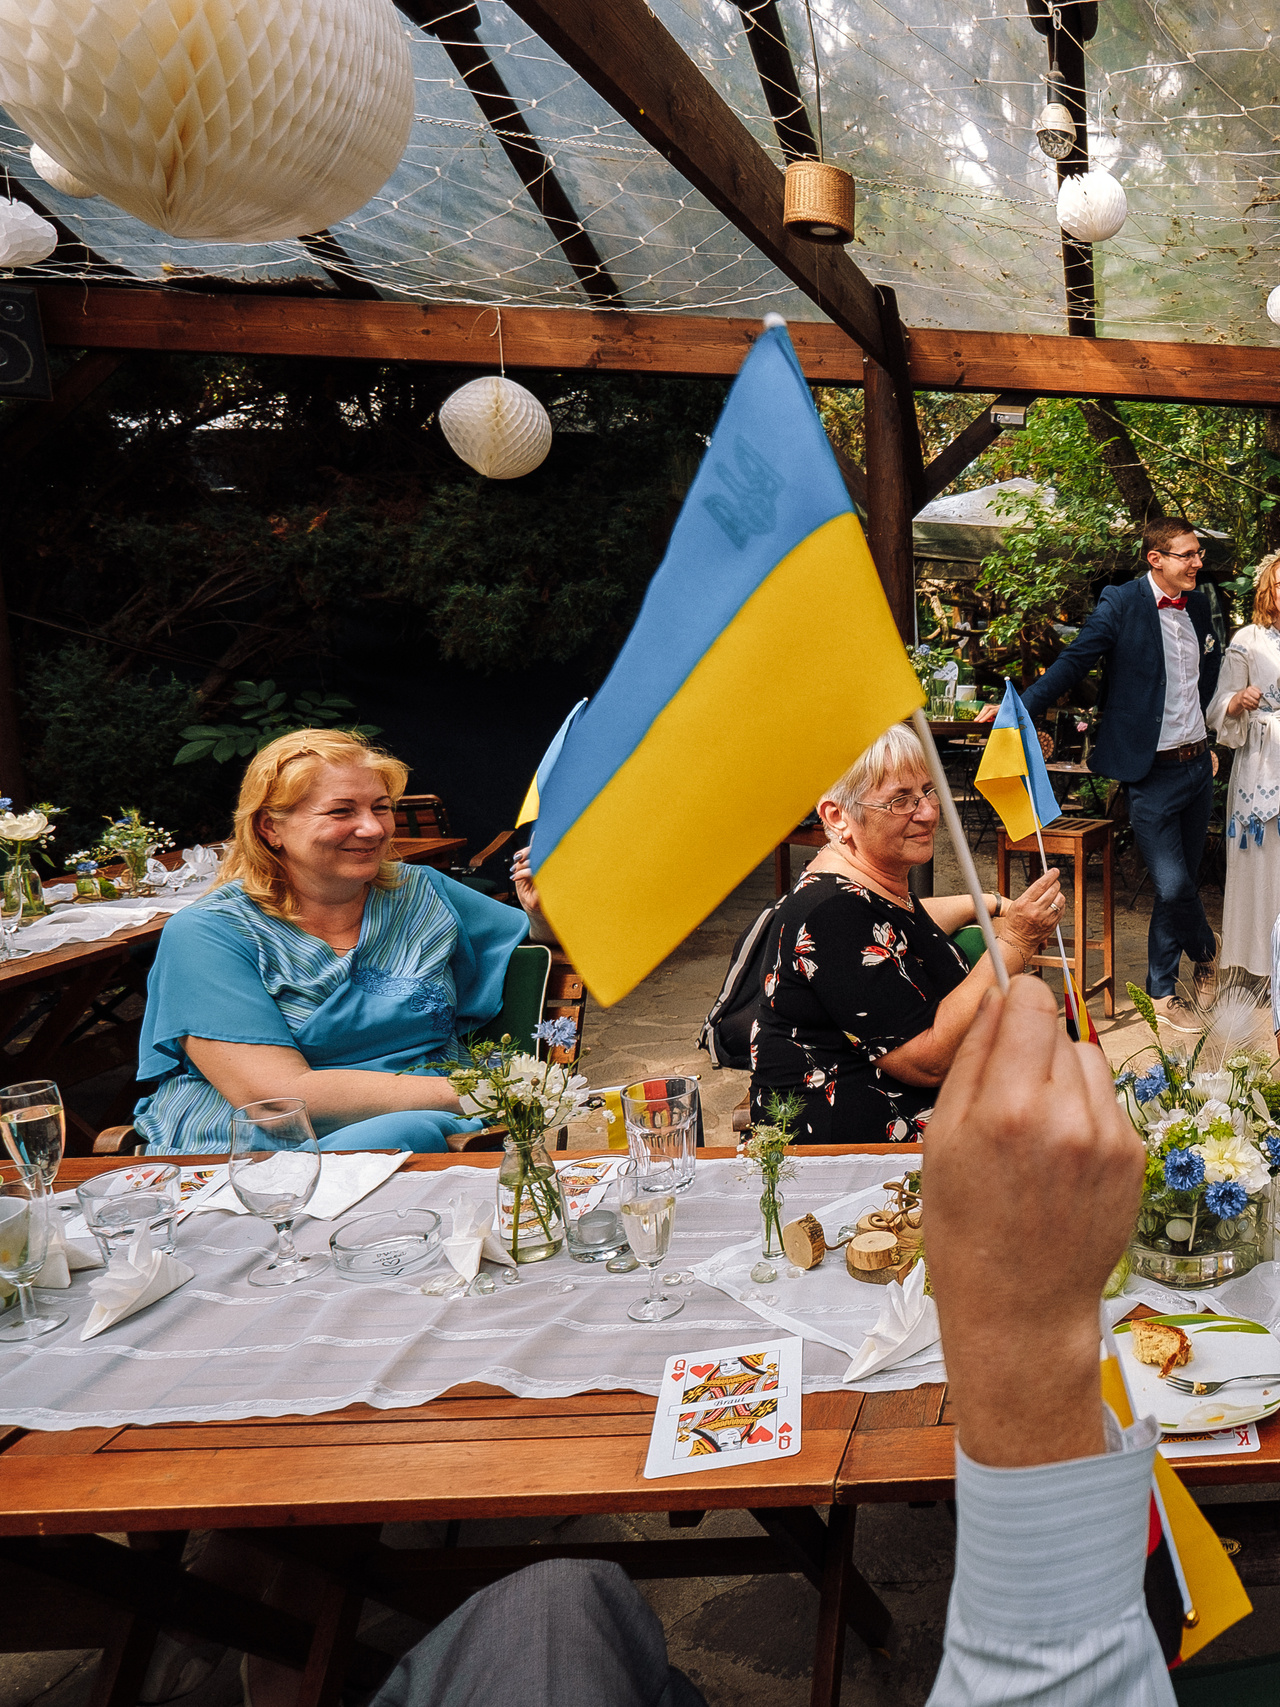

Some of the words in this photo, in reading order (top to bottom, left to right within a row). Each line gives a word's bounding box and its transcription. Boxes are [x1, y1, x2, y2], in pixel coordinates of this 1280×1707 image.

[673, 1359, 686, 1371] Q
[714, 1397, 745, 1406] Braut
[779, 1435, 792, 1450] Q
[1235, 1430, 1251, 1446] K
